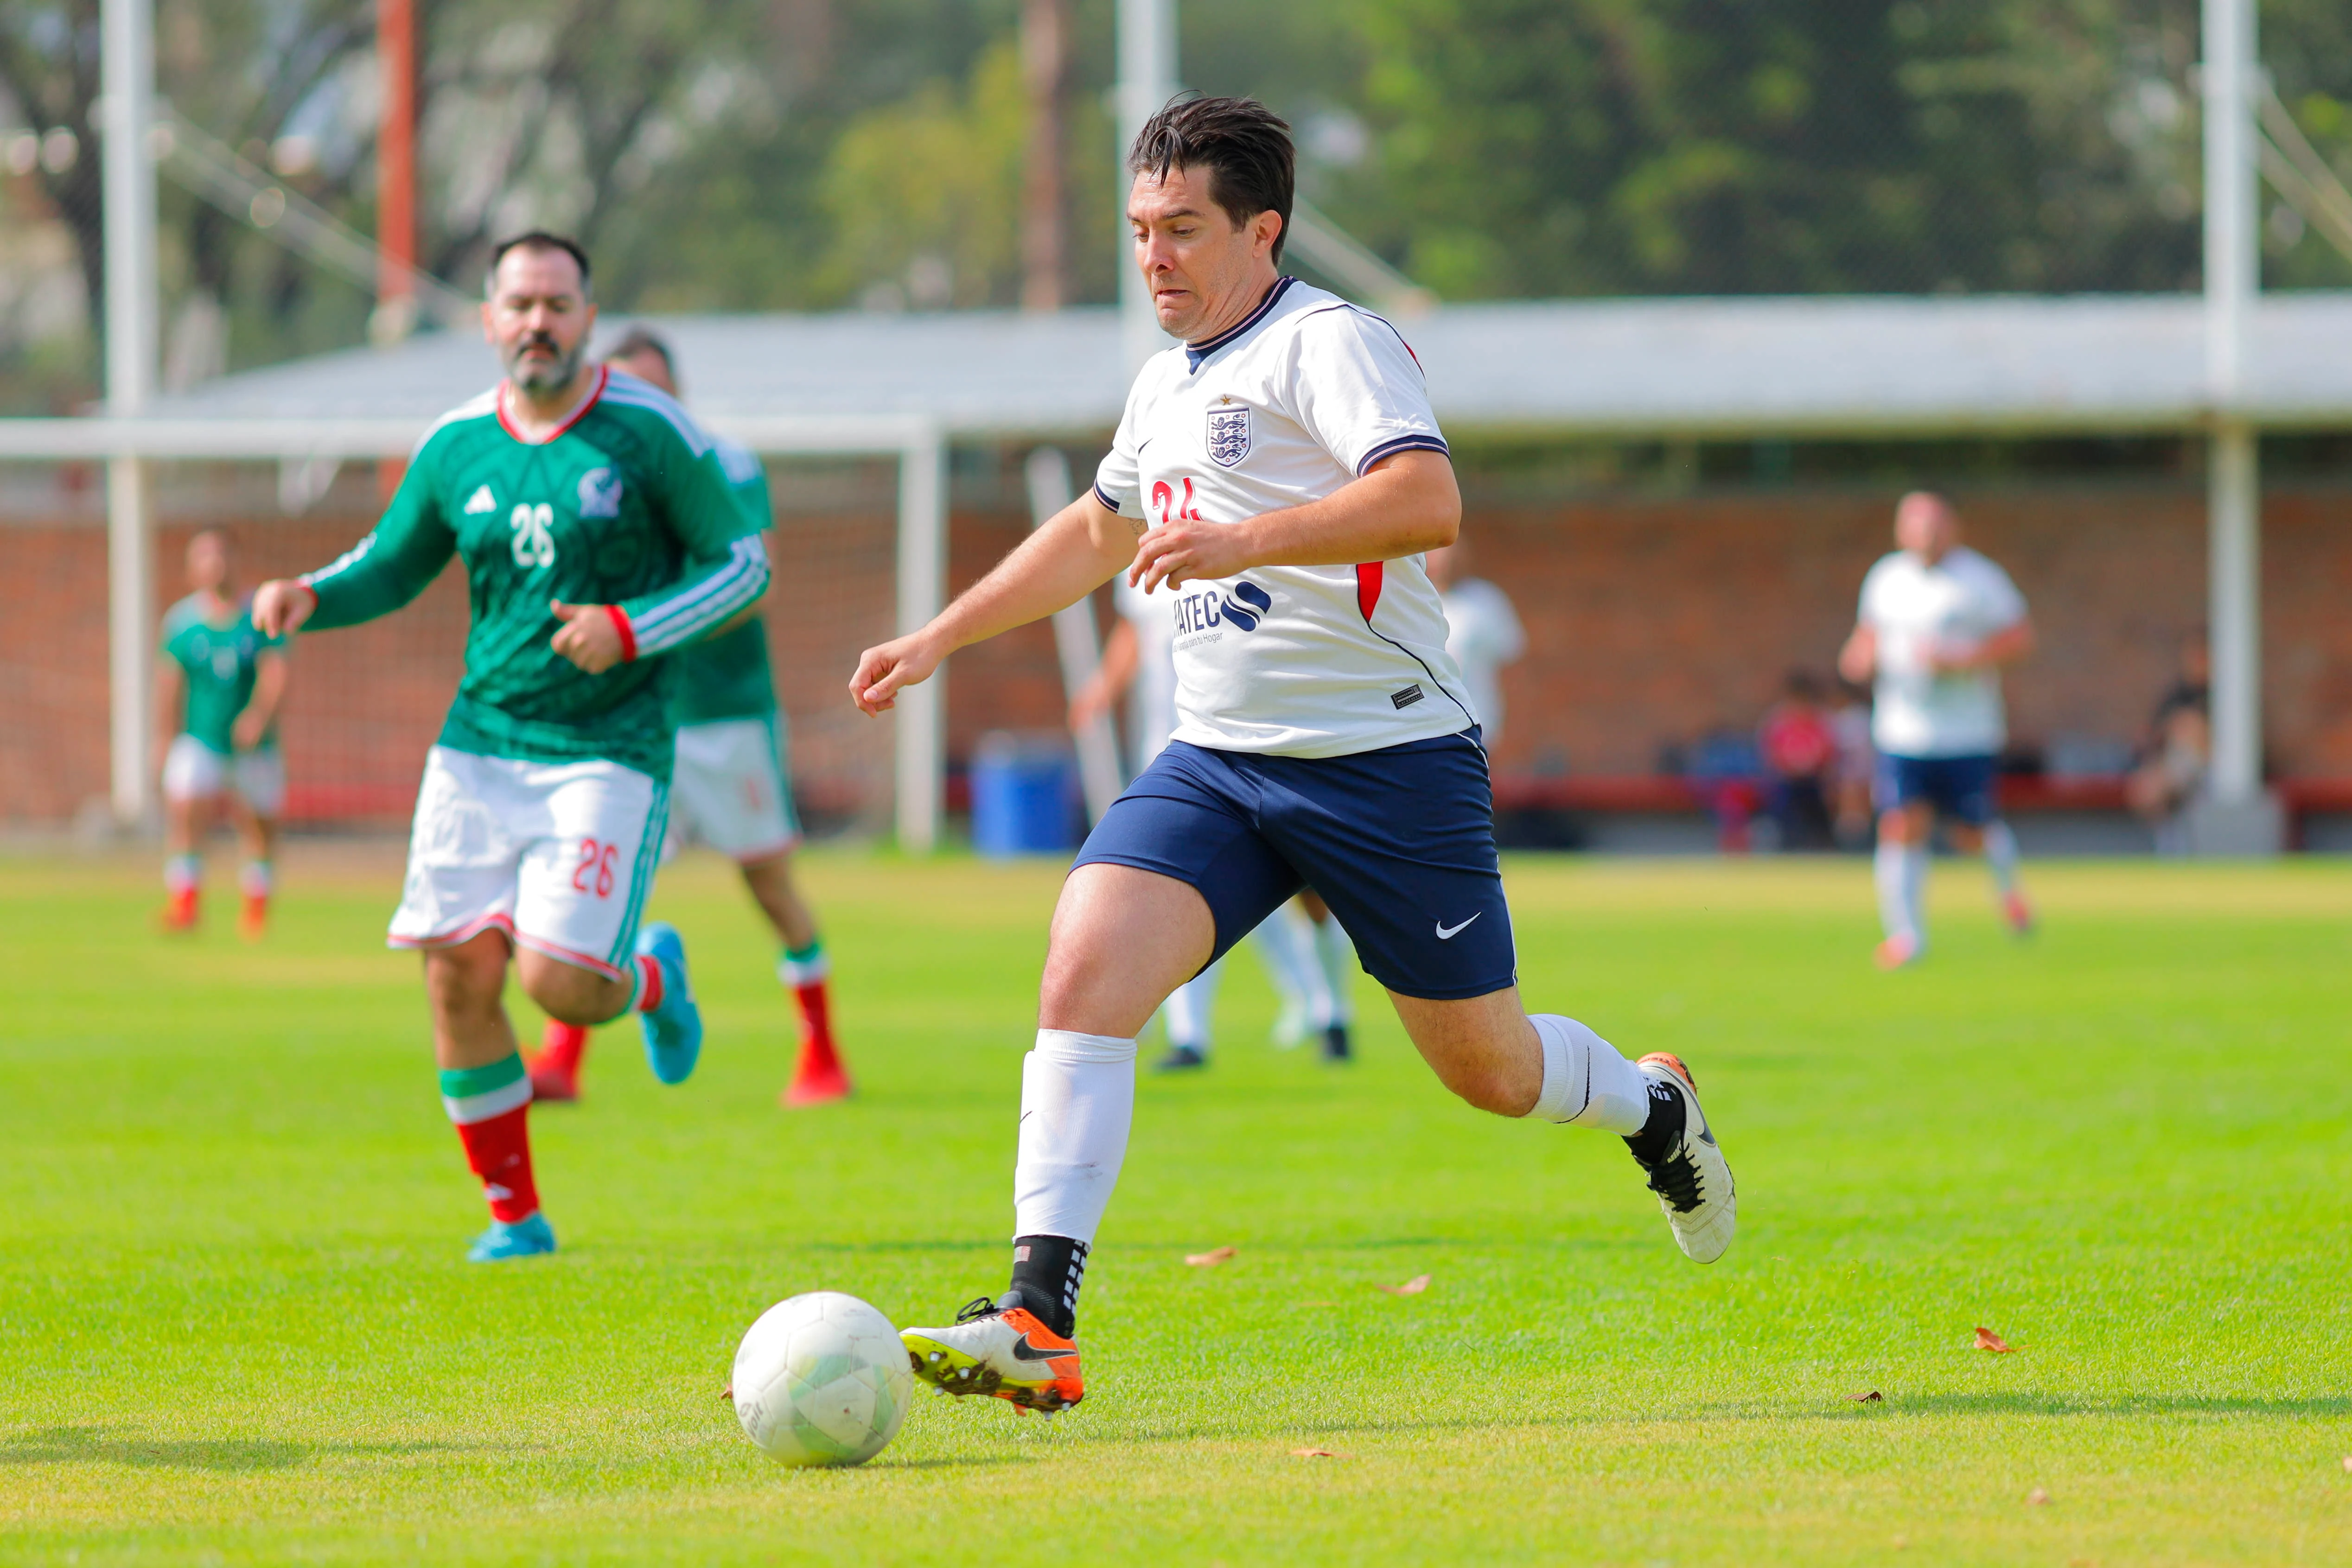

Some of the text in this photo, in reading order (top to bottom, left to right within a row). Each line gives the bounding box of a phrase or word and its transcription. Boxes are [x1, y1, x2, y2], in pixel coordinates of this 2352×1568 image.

[510, 502, 555, 568] 26
[1197, 636, 1203, 645] tu
[1203, 632, 1223, 643] Hogar
[573, 838, 618, 898] 26
